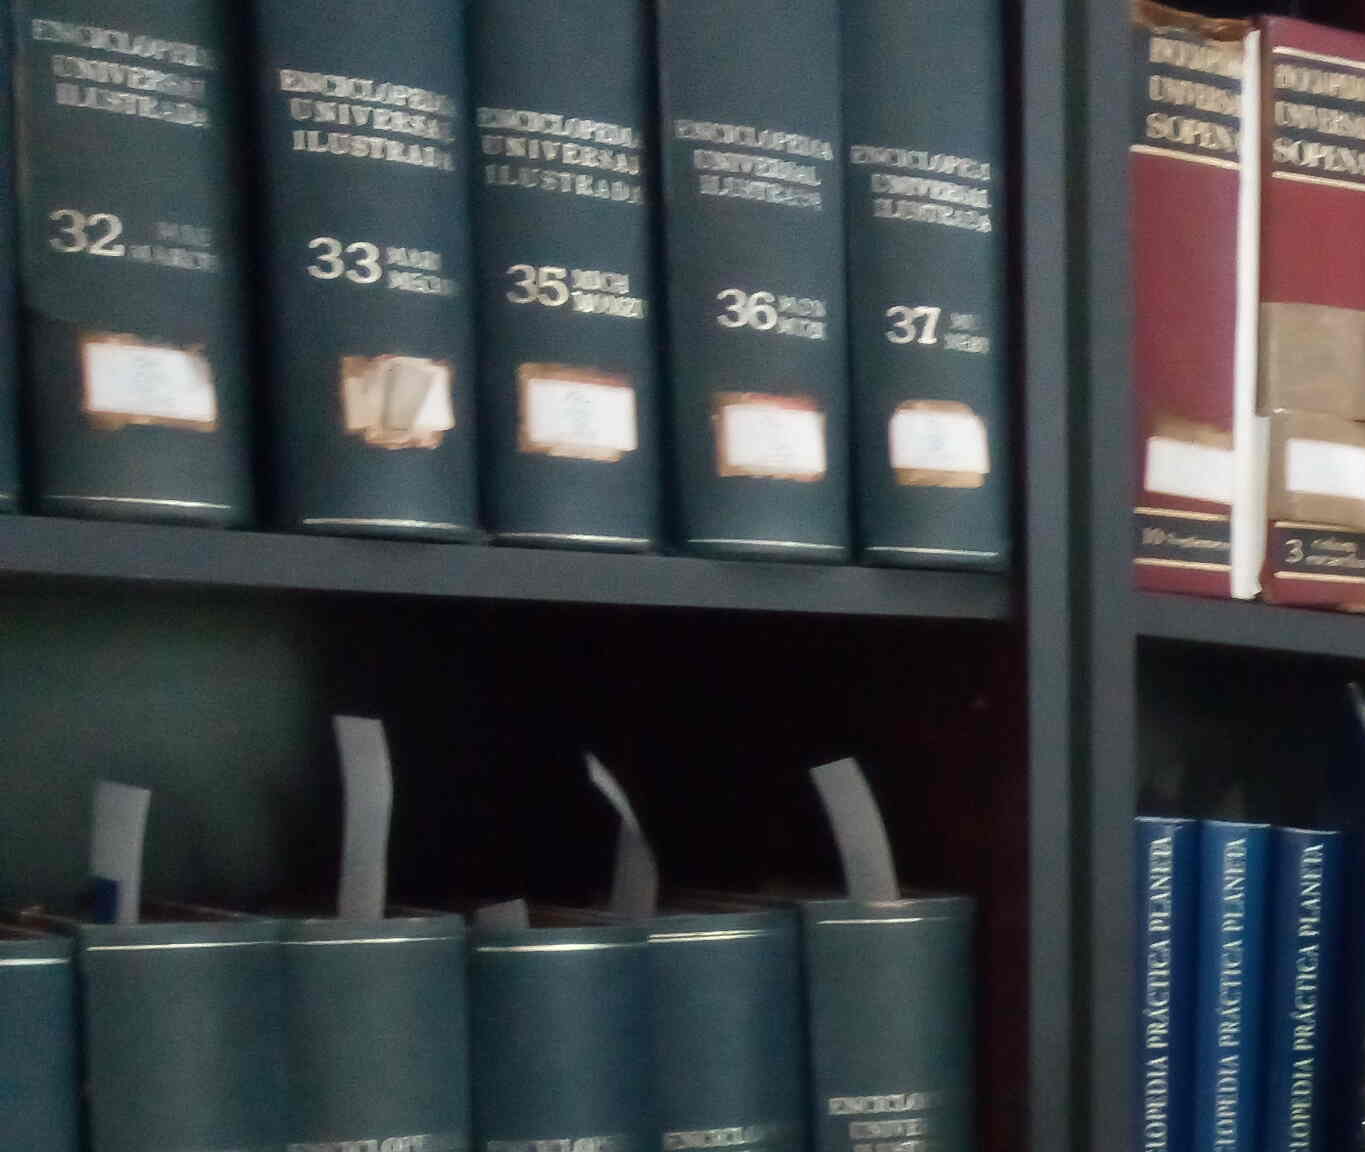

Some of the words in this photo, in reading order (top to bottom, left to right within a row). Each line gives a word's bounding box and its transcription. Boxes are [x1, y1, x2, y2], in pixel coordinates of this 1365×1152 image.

[49, 209, 124, 256] 32
[307, 236, 383, 284] 33
[505, 264, 570, 306] 35
[716, 288, 777, 331] 36
[885, 305, 941, 345] 37
[1146, 836, 1173, 933] PLANETA
[1221, 838, 1248, 934] PLANETA
[1297, 843, 1325, 937] PLANETA
[1141, 940, 1171, 1049] PRÁCTICA
[1214, 938, 1243, 1048] PRÁCTICA
[1290, 945, 1319, 1051] PRÁCTICA
